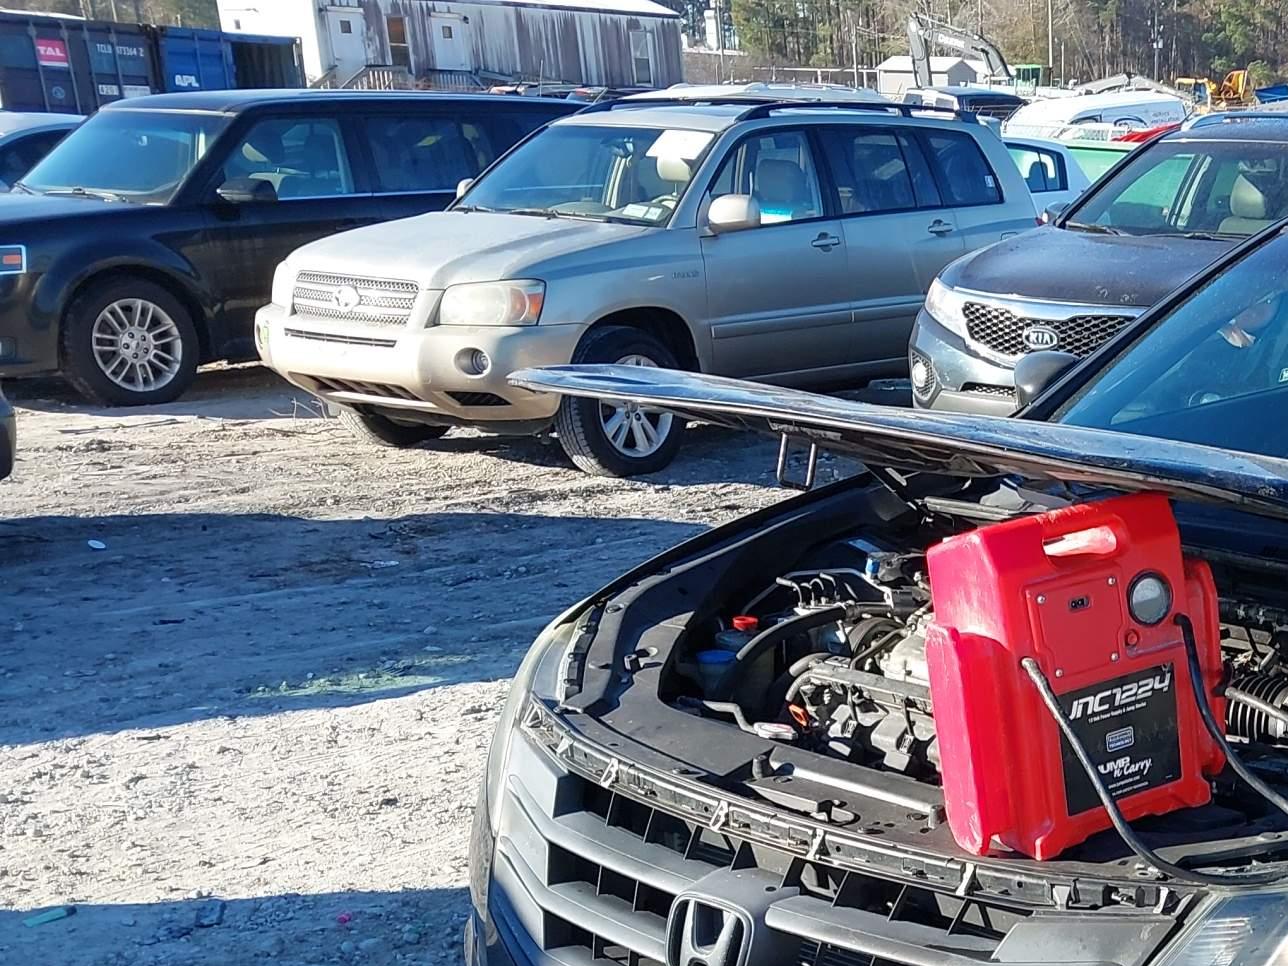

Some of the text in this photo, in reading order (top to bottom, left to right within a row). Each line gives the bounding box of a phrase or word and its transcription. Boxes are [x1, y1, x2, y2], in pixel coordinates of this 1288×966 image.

[37, 46, 65, 57] TAL
[175, 74, 200, 87] APL
[1029, 331, 1051, 345] KIA
[1069, 672, 1171, 720] JNC1224
[1098, 756, 1131, 774] UMP
